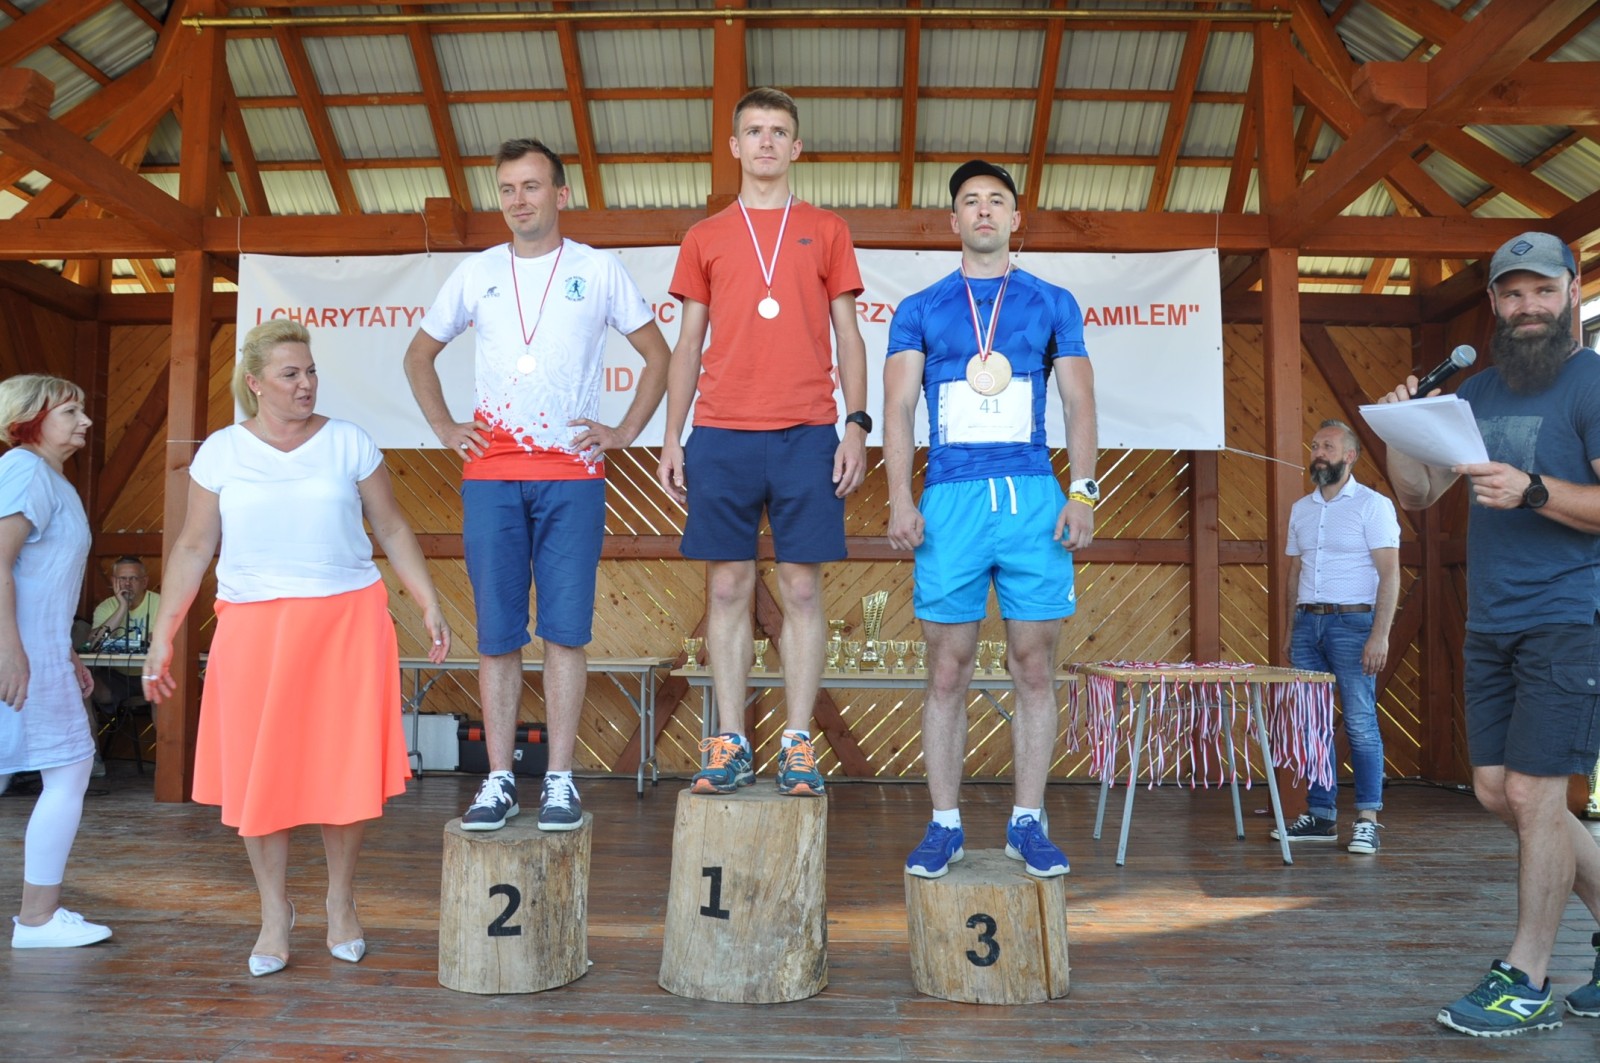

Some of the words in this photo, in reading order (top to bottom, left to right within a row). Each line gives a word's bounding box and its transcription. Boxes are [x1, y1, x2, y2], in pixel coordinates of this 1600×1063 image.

[270, 306, 426, 328] CHARYTATY
[1083, 303, 1200, 326] AMILEM"
[979, 398, 1001, 414] 41
[486, 883, 522, 937] 2
[699, 865, 731, 920] 1
[965, 913, 1000, 967] 3
